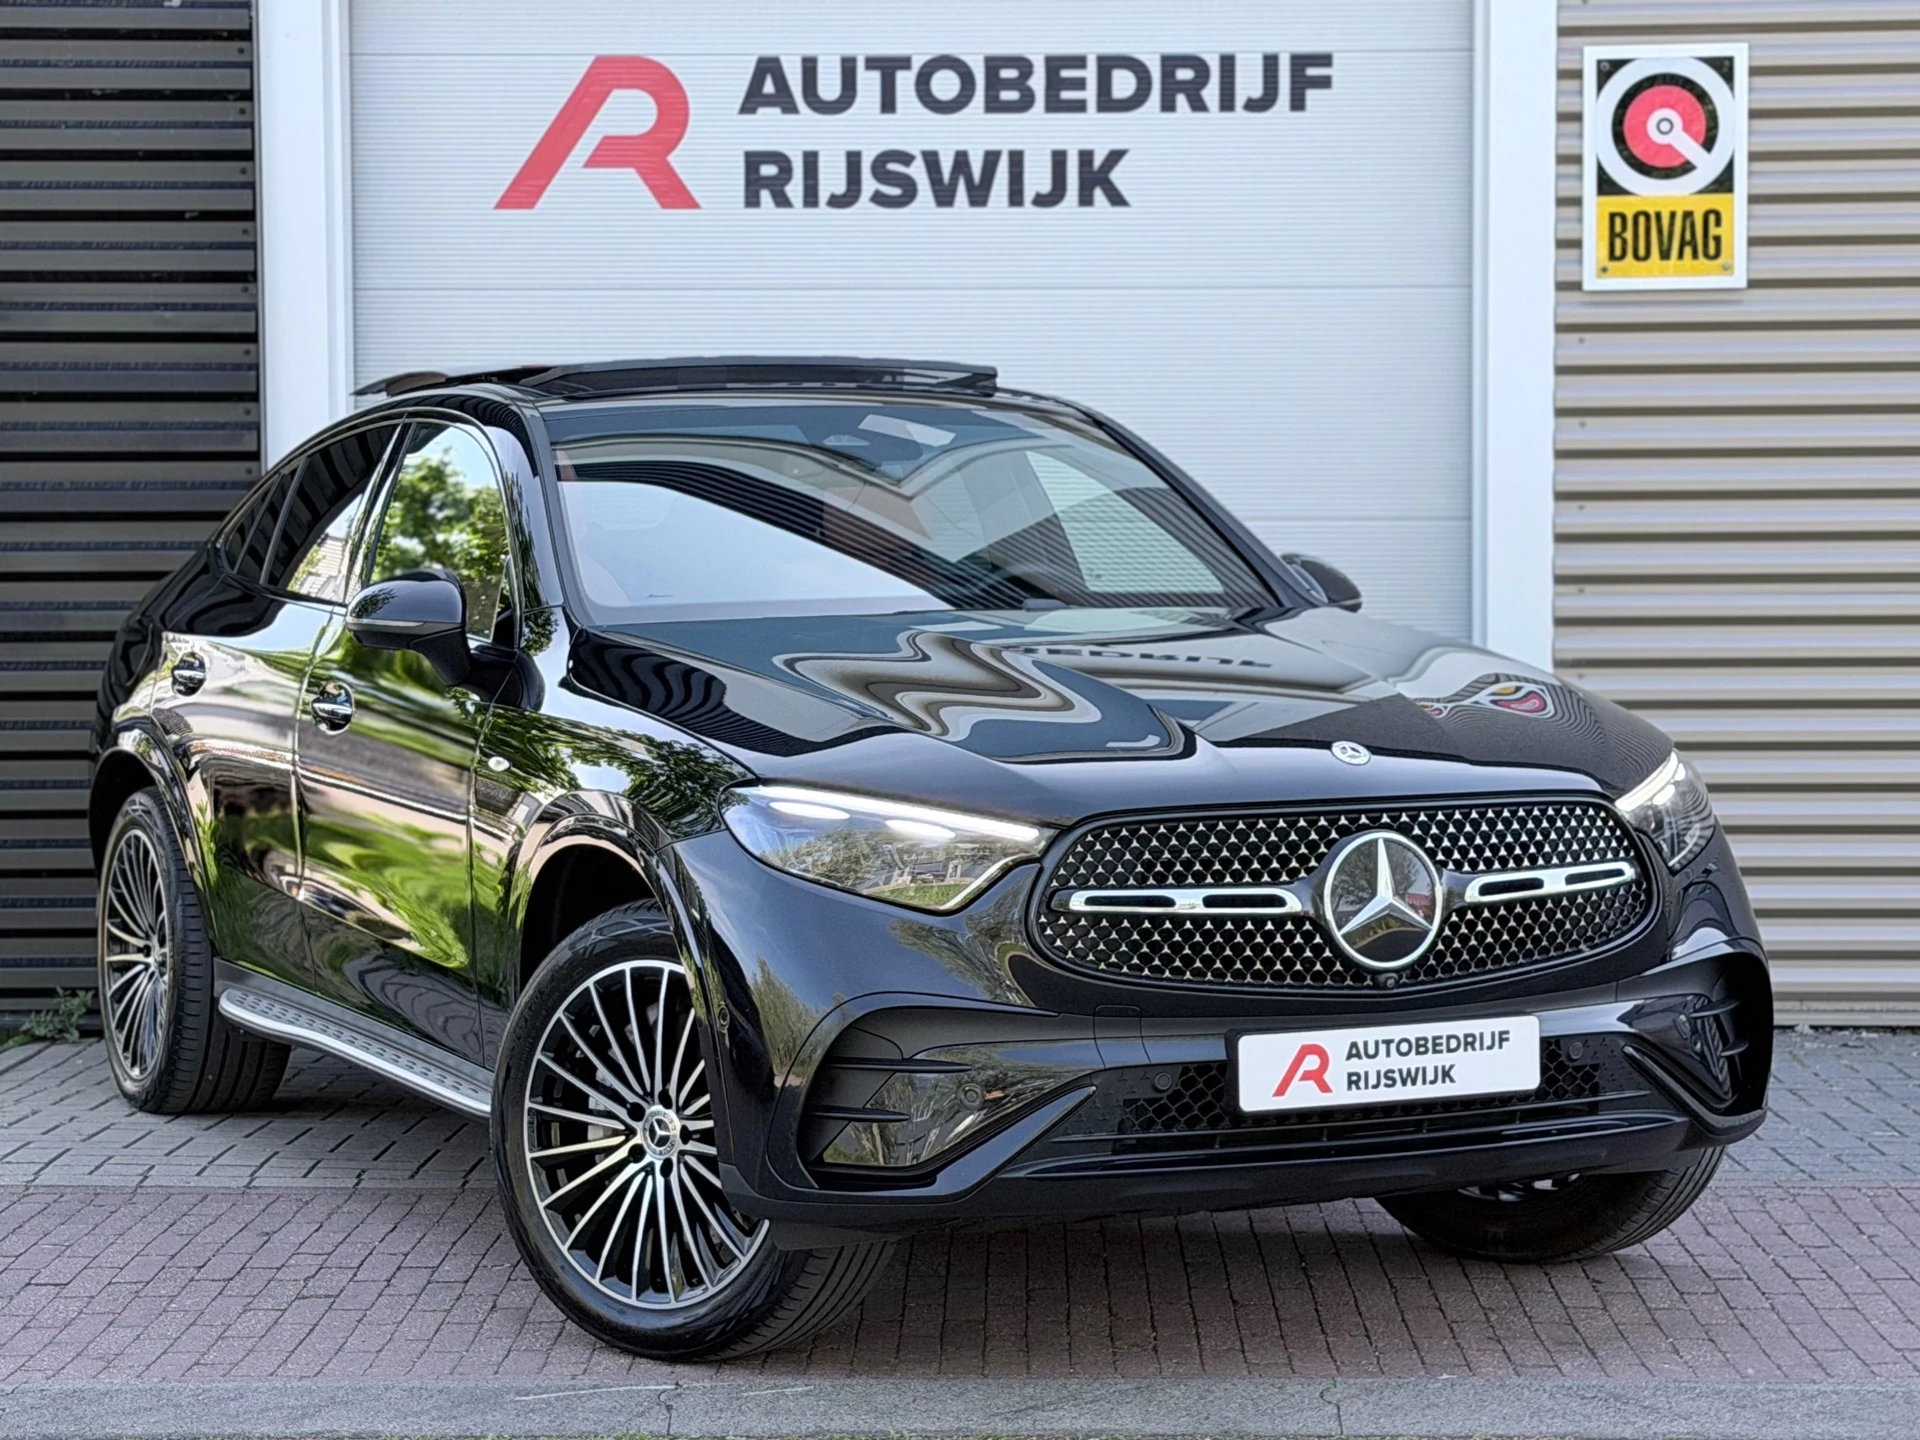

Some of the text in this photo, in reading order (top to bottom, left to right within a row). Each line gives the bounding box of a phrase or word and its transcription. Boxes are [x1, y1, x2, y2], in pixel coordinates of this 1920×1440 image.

[738, 53, 1333, 115] AUTOBEDRIJF
[744, 150, 1130, 209] RIJSWIJK
[1608, 209, 1722, 262] BOVAG
[1345, 1029, 1510, 1061] AUTOBEDRIJF
[1346, 1064, 1457, 1091] RIJSWIJK
